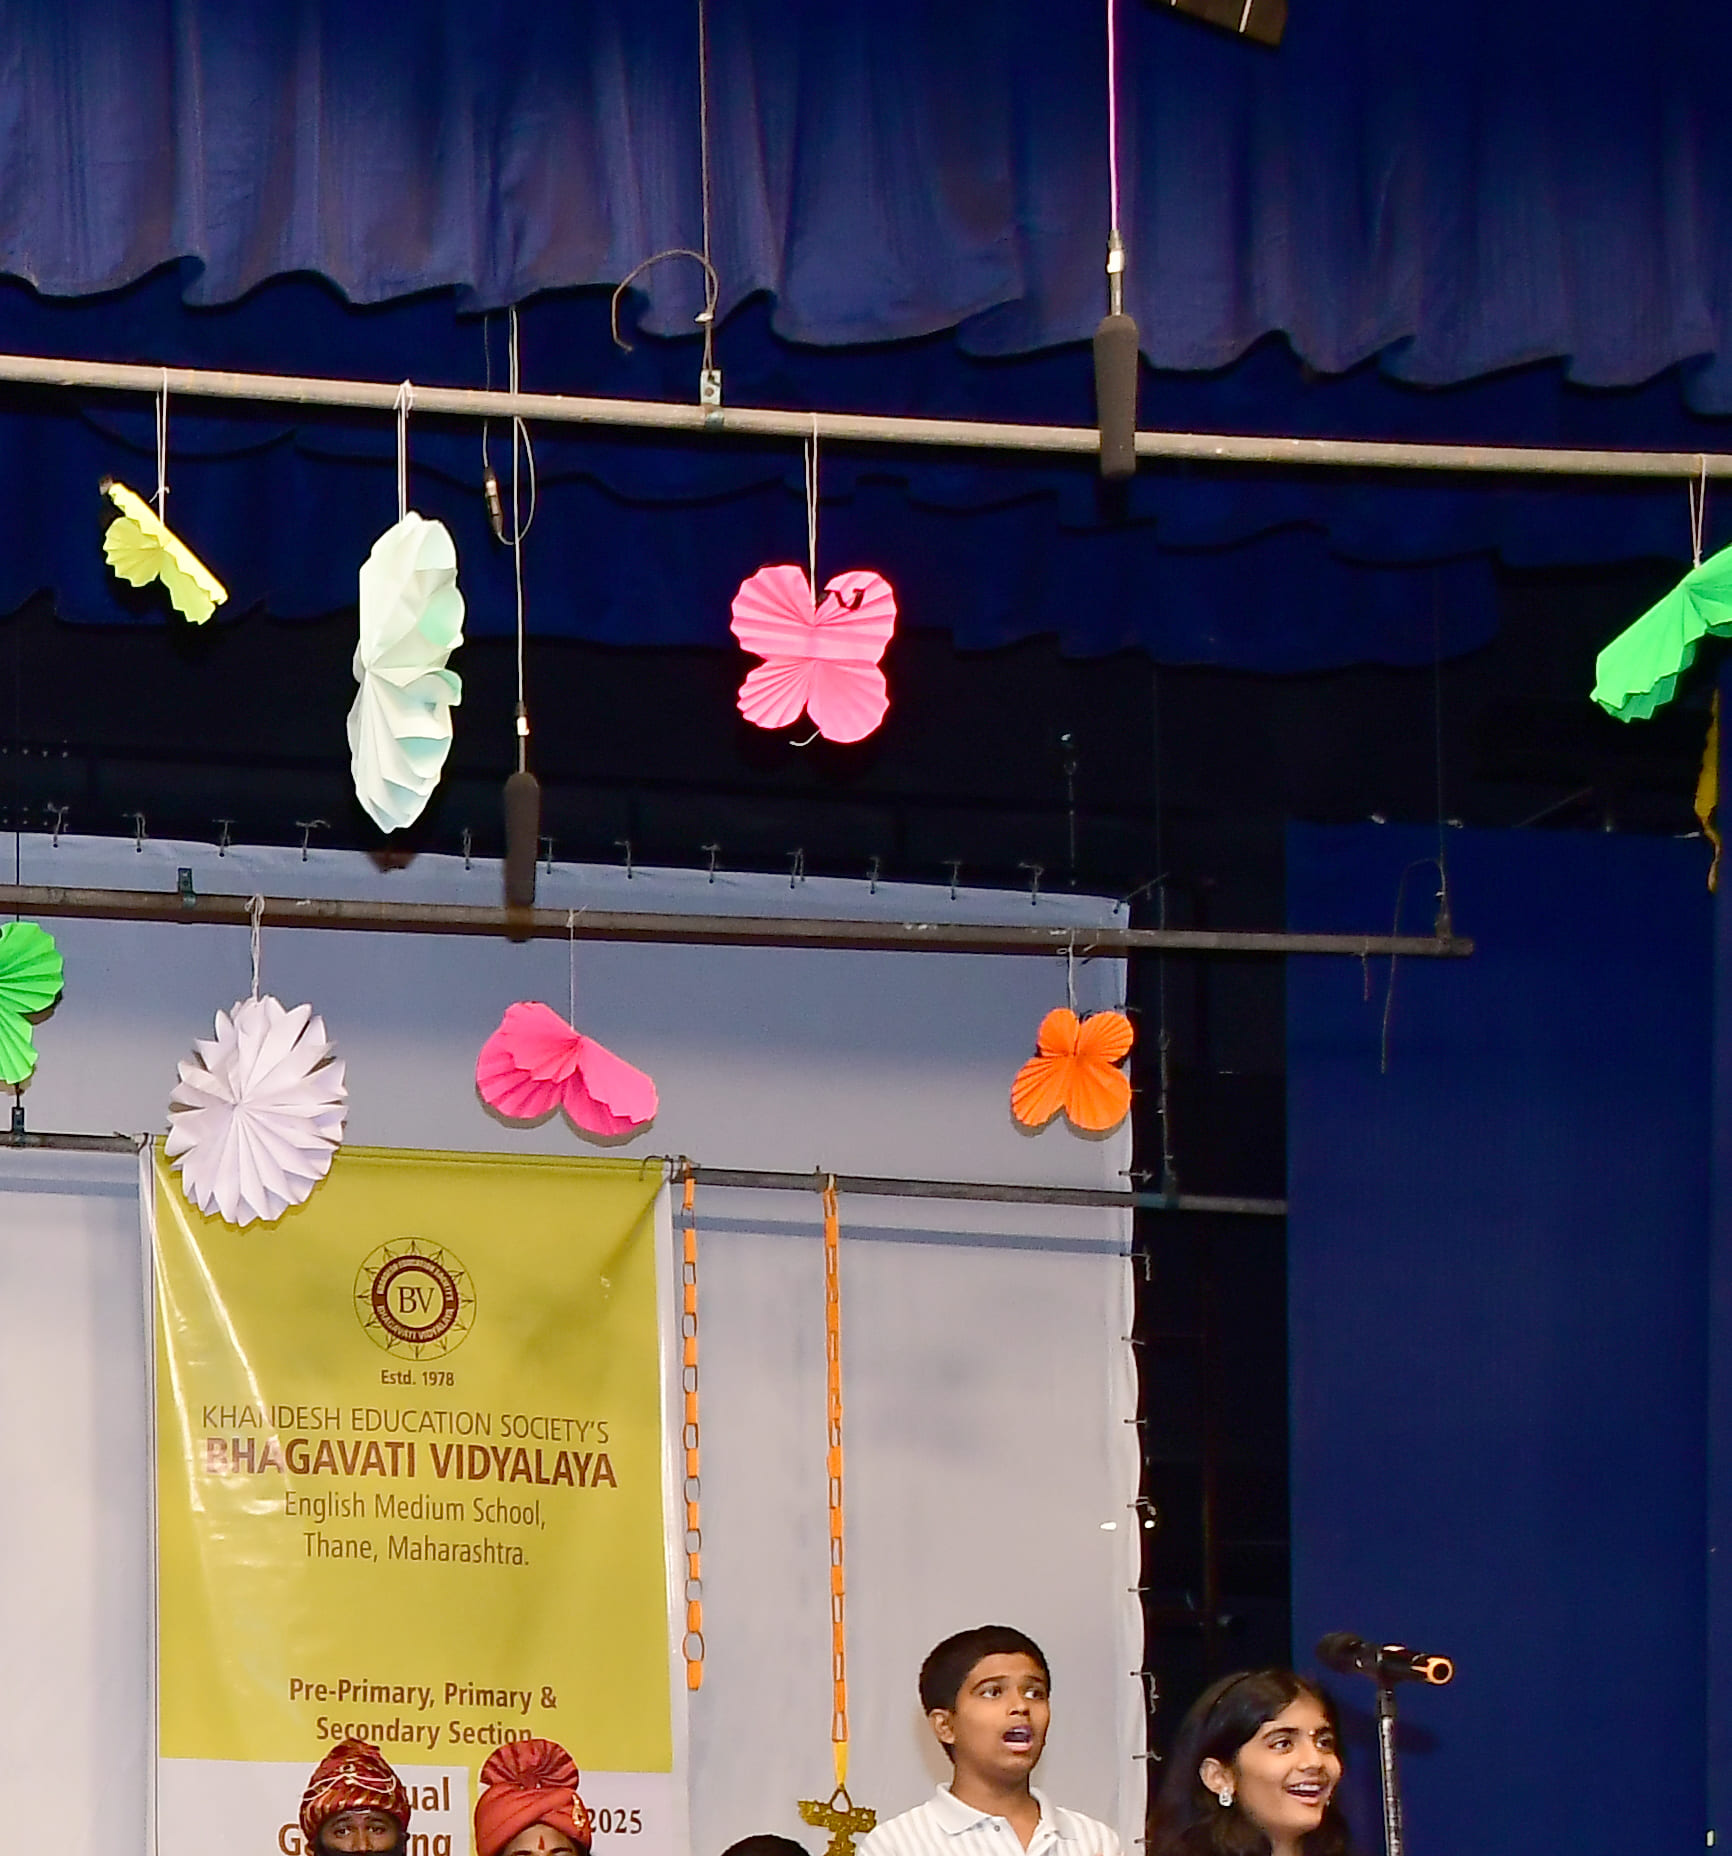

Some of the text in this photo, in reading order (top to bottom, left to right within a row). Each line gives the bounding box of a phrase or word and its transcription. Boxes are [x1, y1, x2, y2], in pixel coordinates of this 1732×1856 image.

[397, 1286, 435, 1314] BV
[380, 1369, 455, 1386] Estd. 1978
[202, 1404, 609, 1444] KHANDESH EDUCATION SOCIETY'S
[205, 1437, 619, 1489] BHAGAVATI VIDYALAYA
[285, 1491, 546, 1531] English Medium School,
[303, 1531, 530, 1566] Thane, Maharashtra.
[289, 1678, 557, 1714] Pre-Primary, Primary &
[316, 1716, 533, 1750] Secondary Section
